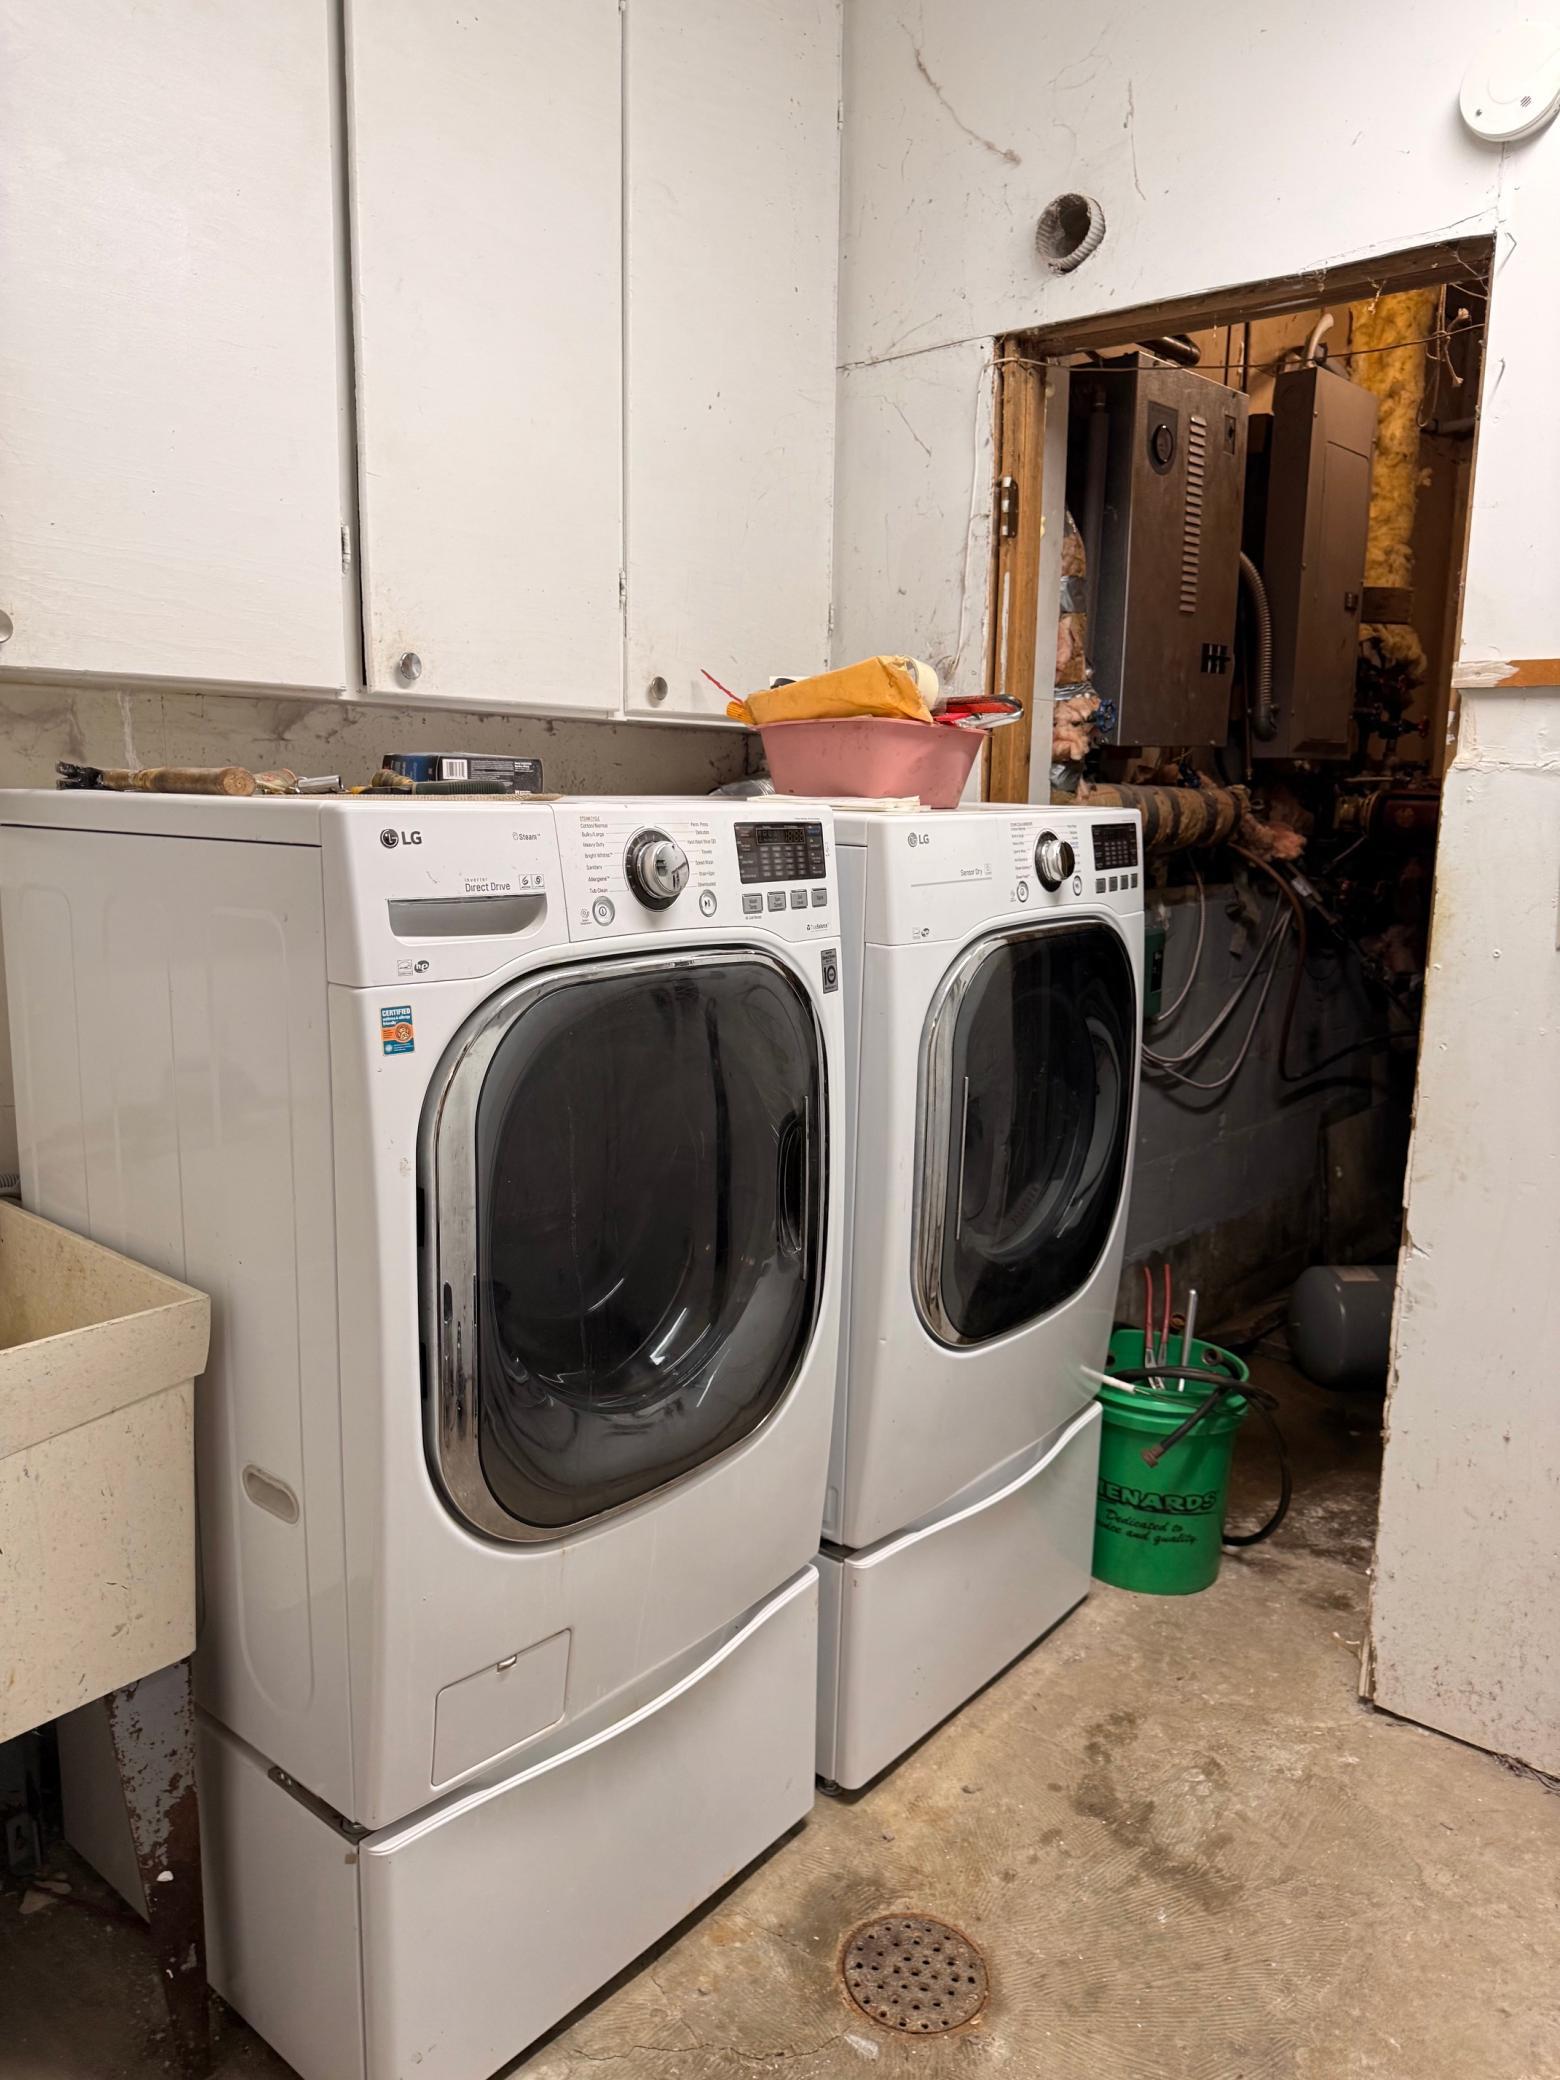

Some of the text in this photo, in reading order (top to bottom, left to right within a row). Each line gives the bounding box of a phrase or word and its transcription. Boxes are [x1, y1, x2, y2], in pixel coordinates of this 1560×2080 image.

[401, 830, 422, 845] LG
[919, 833, 930, 845] LG
[959, 867, 983, 877] Sensor Dry
[465, 881, 490, 892] Direct
[490, 881, 511, 891] Drive
[382, 1008, 411, 1017] CERTIFIED
[1105, 1508, 1184, 1532] Dedicated to
[1125, 1530, 1151, 1541] and
